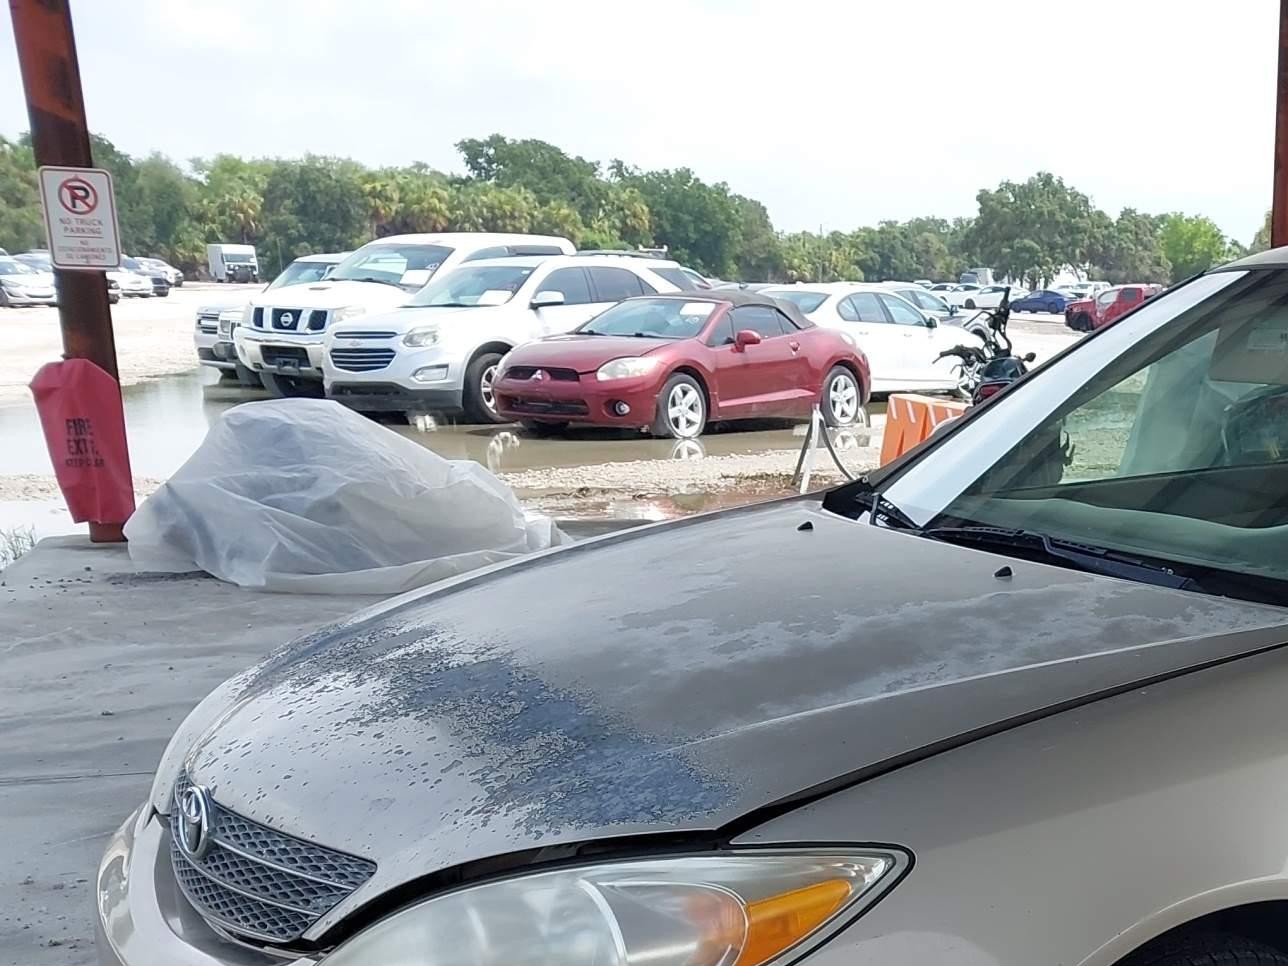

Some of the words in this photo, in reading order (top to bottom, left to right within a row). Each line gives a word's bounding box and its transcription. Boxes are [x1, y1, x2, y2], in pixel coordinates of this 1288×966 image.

[59, 217, 72, 225] NO
[74, 218, 104, 227] TRUCK
[63, 226, 102, 235] PARKING
[65, 418, 94, 436] FIRE
